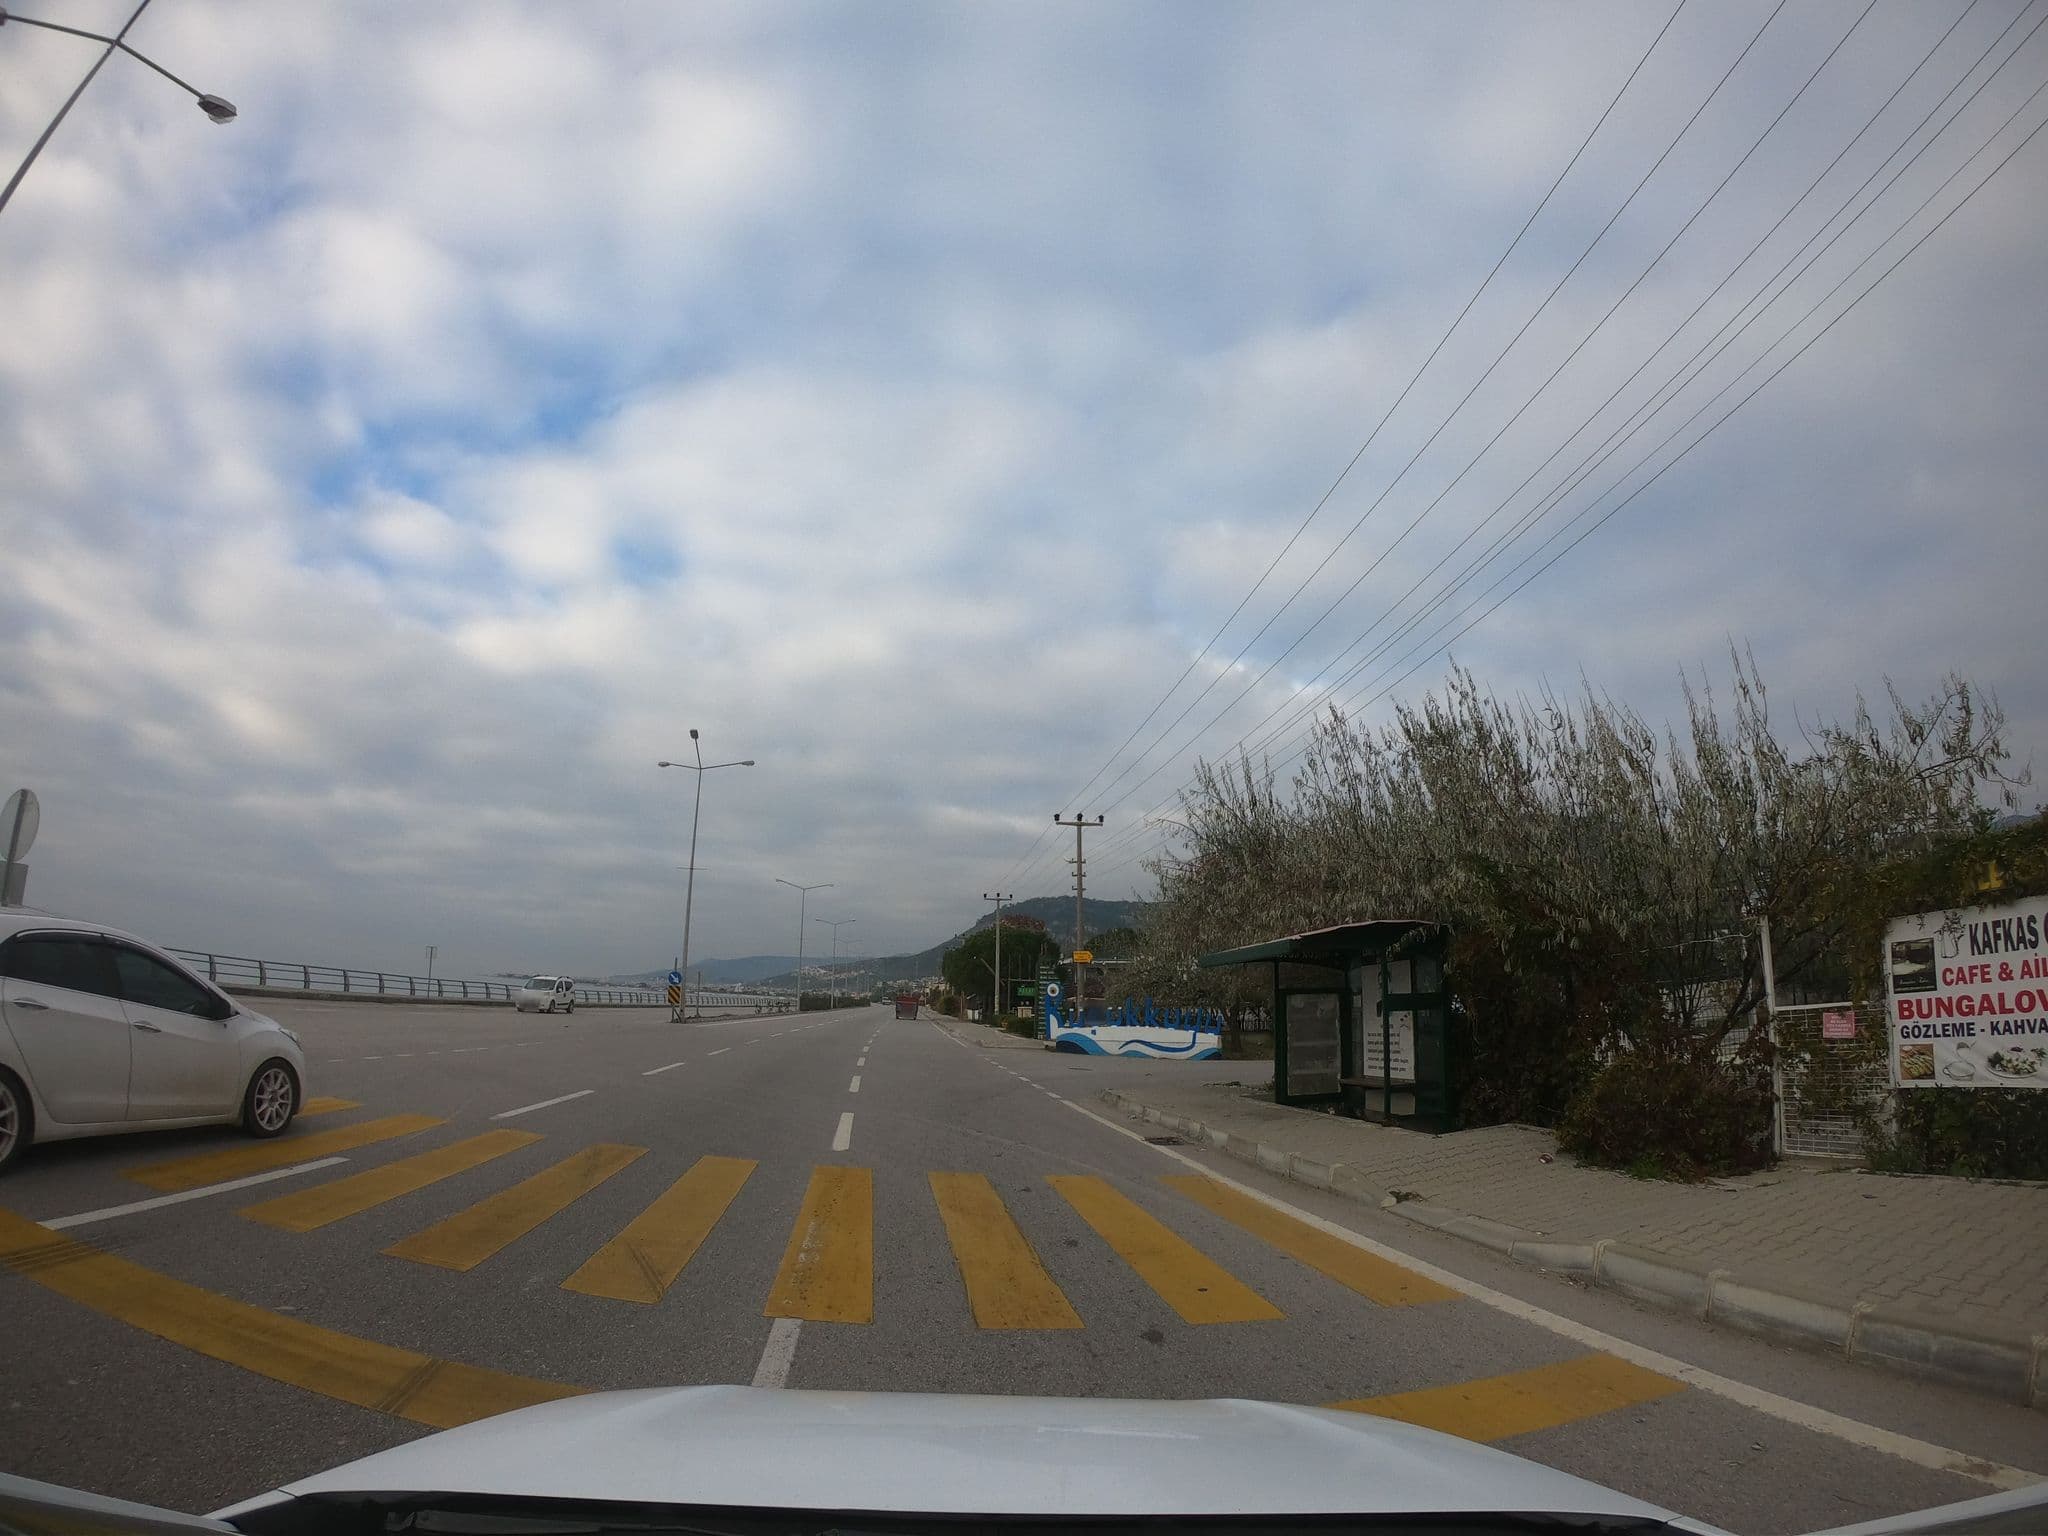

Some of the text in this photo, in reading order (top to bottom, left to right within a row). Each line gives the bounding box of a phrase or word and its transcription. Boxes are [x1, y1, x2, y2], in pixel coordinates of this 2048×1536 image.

[1969, 914, 2039, 956] KAFKAS
[1942, 964, 1993, 987] CAFE
[1998, 962, 2014, 981] &
[1900, 1021, 1977, 1040] GÖZLEME
[1990, 1018, 2048, 1036] KAHVA
